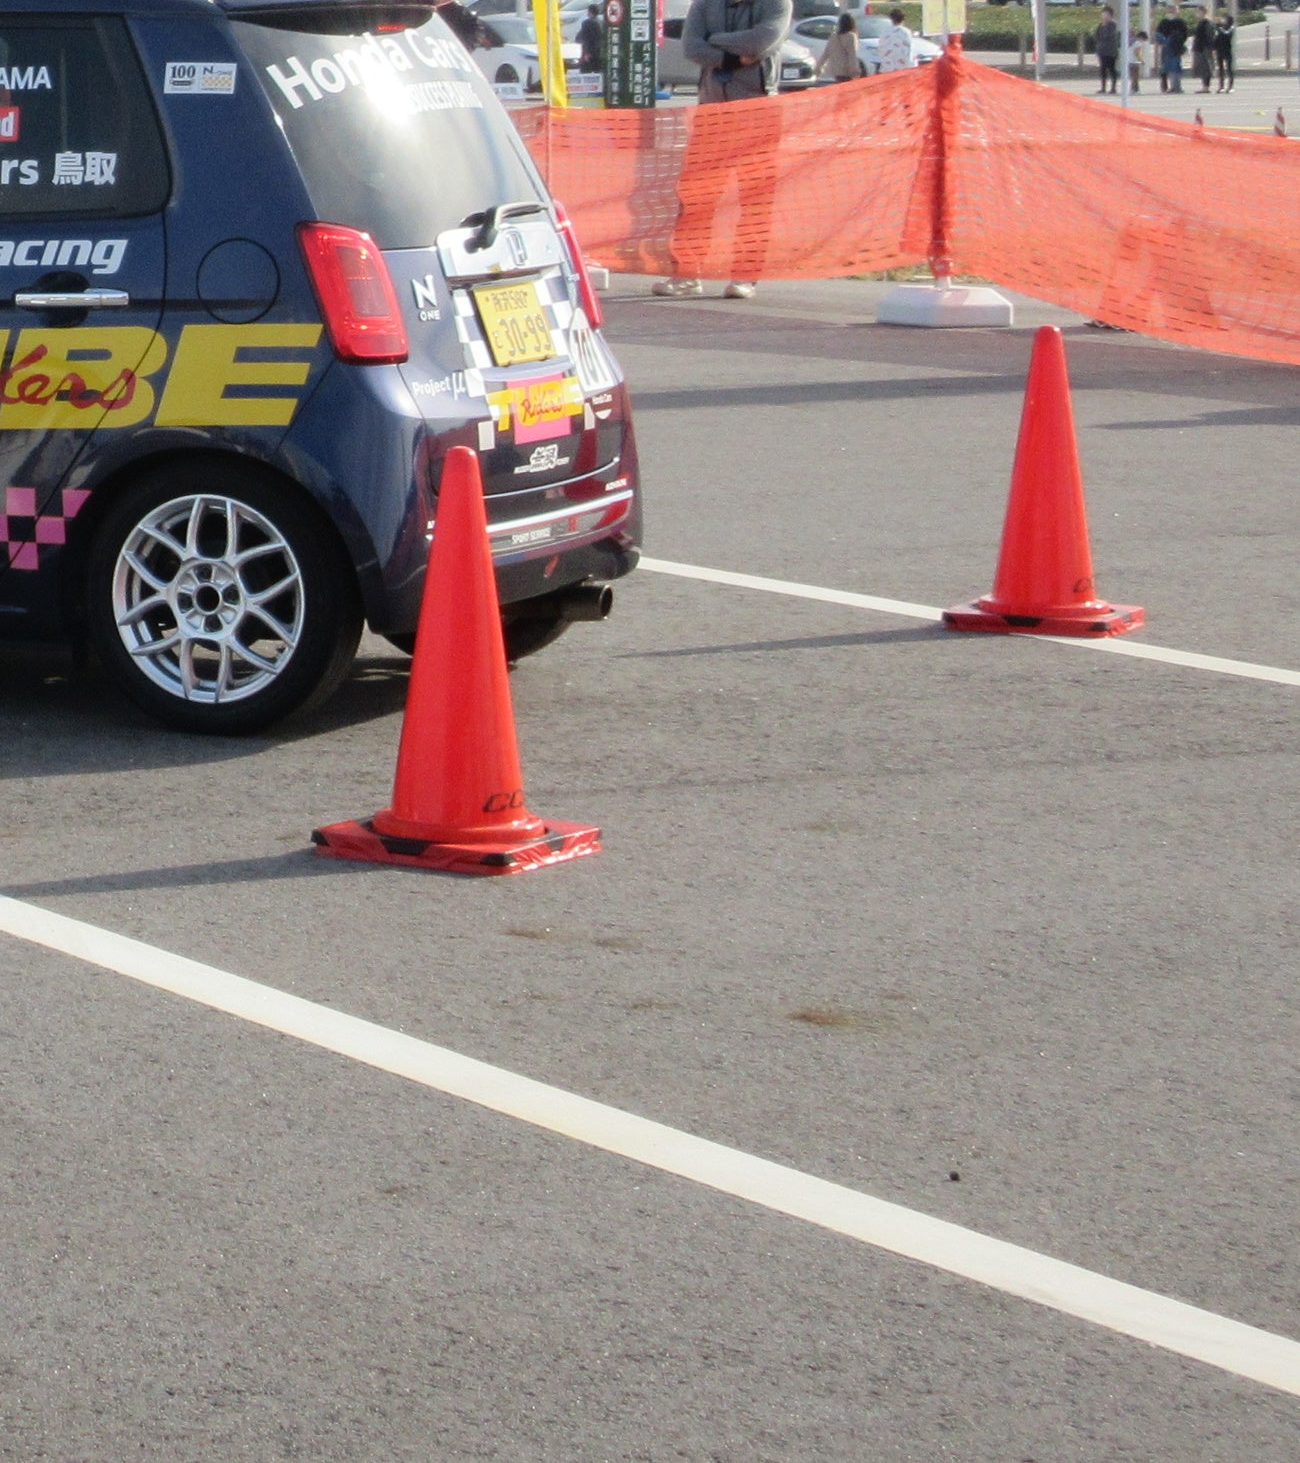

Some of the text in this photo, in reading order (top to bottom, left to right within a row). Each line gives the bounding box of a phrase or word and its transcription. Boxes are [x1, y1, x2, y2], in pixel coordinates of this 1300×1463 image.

[171, 65, 196, 78] 100
[266, 32, 414, 110] Honda
[404, 29, 472, 73] Cars
[52, 151, 117, 186] 鳥取
[411, 274, 438, 309] N
[420, 310, 441, 321] ONE
[411, 375, 451, 397] Project
[487, 376, 584, 432] TUBE
